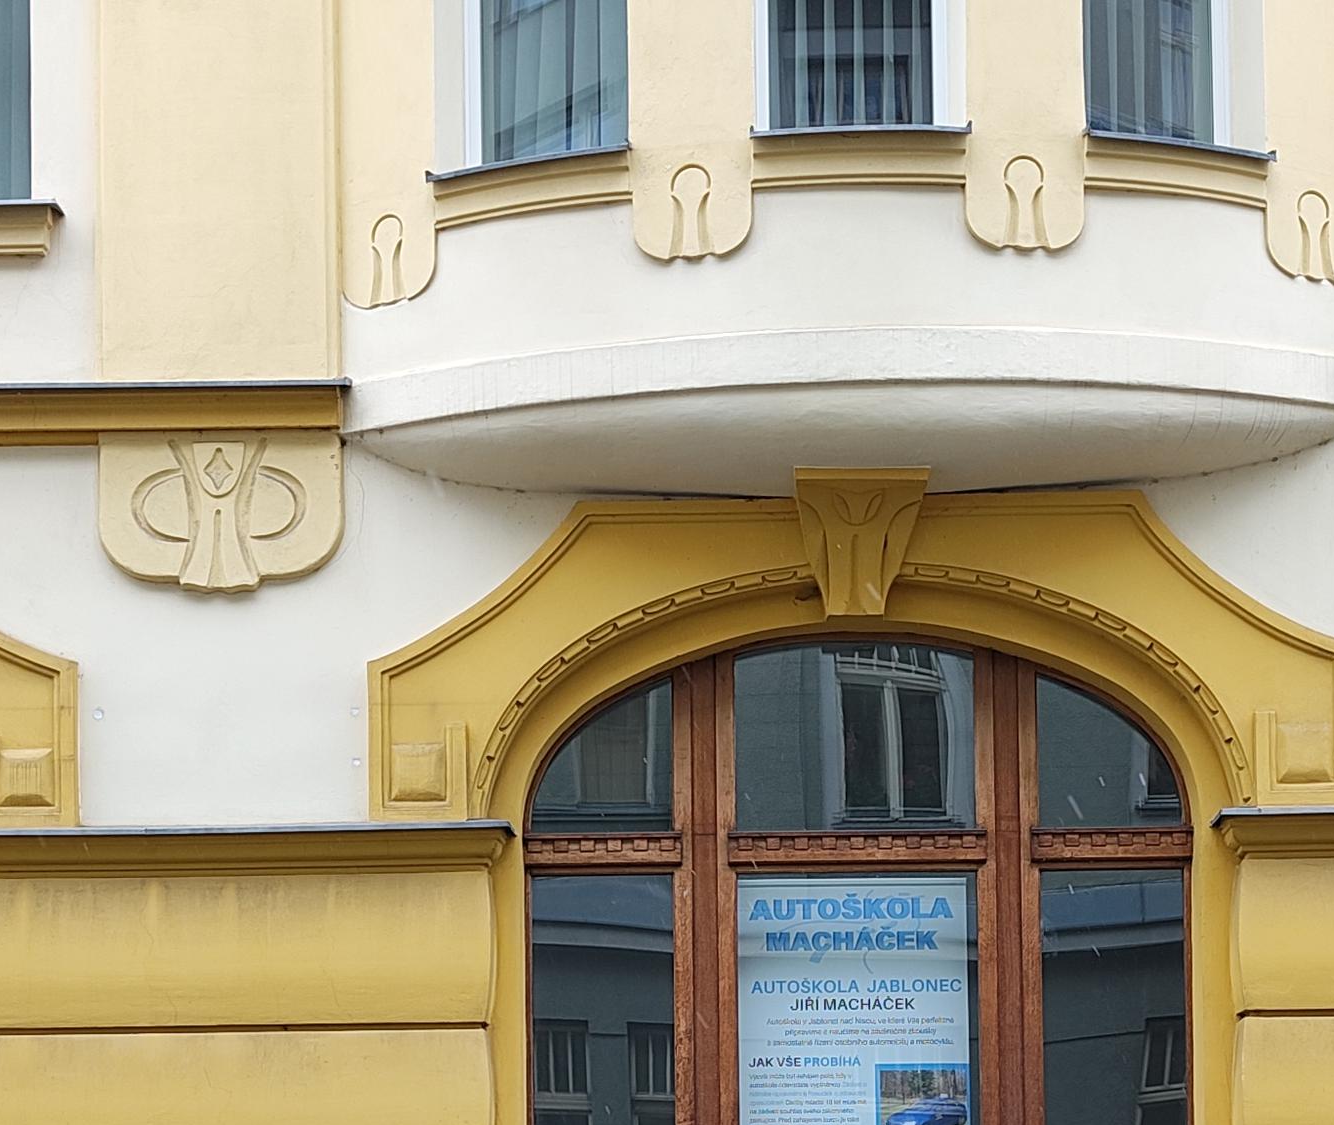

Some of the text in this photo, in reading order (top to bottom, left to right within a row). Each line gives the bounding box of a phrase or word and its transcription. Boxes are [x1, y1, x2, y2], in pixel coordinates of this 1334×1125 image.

[749, 894, 954, 920] AUTOŠKOLA
[766, 926, 938, 952] MACHÁČEK
[752, 978, 962, 994] AUTOŠKOLA JABLONEC
[790, 995, 915, 1011] JIŘÍ MACHÁČEK
[749, 1055, 861, 1067] JAK VŠE PROBÍHÁ
